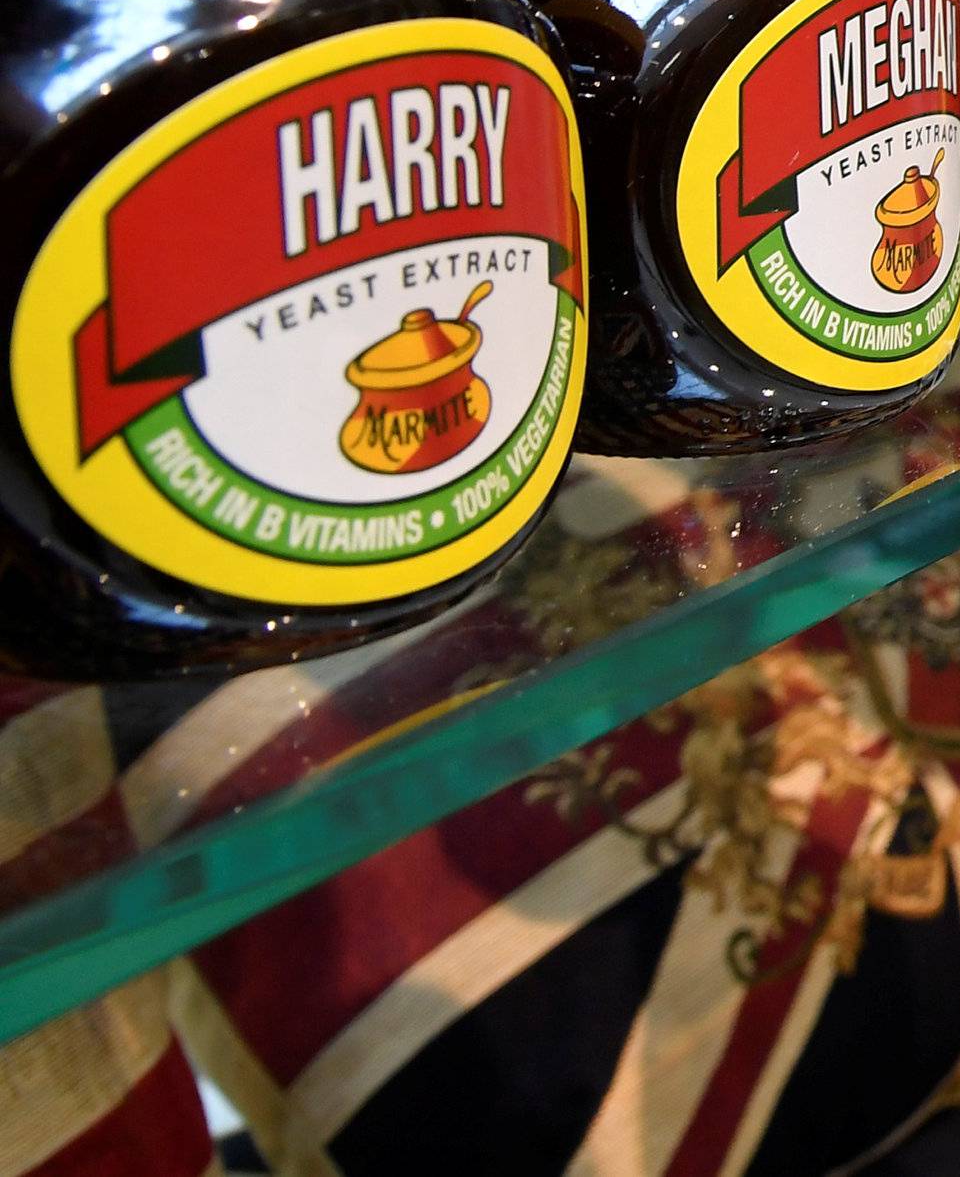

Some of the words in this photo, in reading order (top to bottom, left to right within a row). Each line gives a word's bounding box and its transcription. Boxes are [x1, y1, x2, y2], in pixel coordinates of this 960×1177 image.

[278, 83, 510, 258] HARRY
[819, 136, 893, 187] YEAST
[904, 123, 958, 151] EXTRACT
[245, 275, 378, 342] YEAST
[402, 249, 532, 289] EXTRACT
[759, 249, 806, 311] RICH
[799, 296, 827, 330] IN
[823, 310, 842, 339] B
[841, 319, 914, 352] VITAMINS
[924, 292, 951, 336] 100%
[145, 427, 223, 509] RICH
[212, 486, 258, 532] IN
[254, 503, 286, 542] B
[287, 508, 425, 554] VITAMINS
[451, 465, 511, 523] 100%
[505, 316, 572, 477] VEGETARIAN
[351, 386, 477, 462] MARMITE
